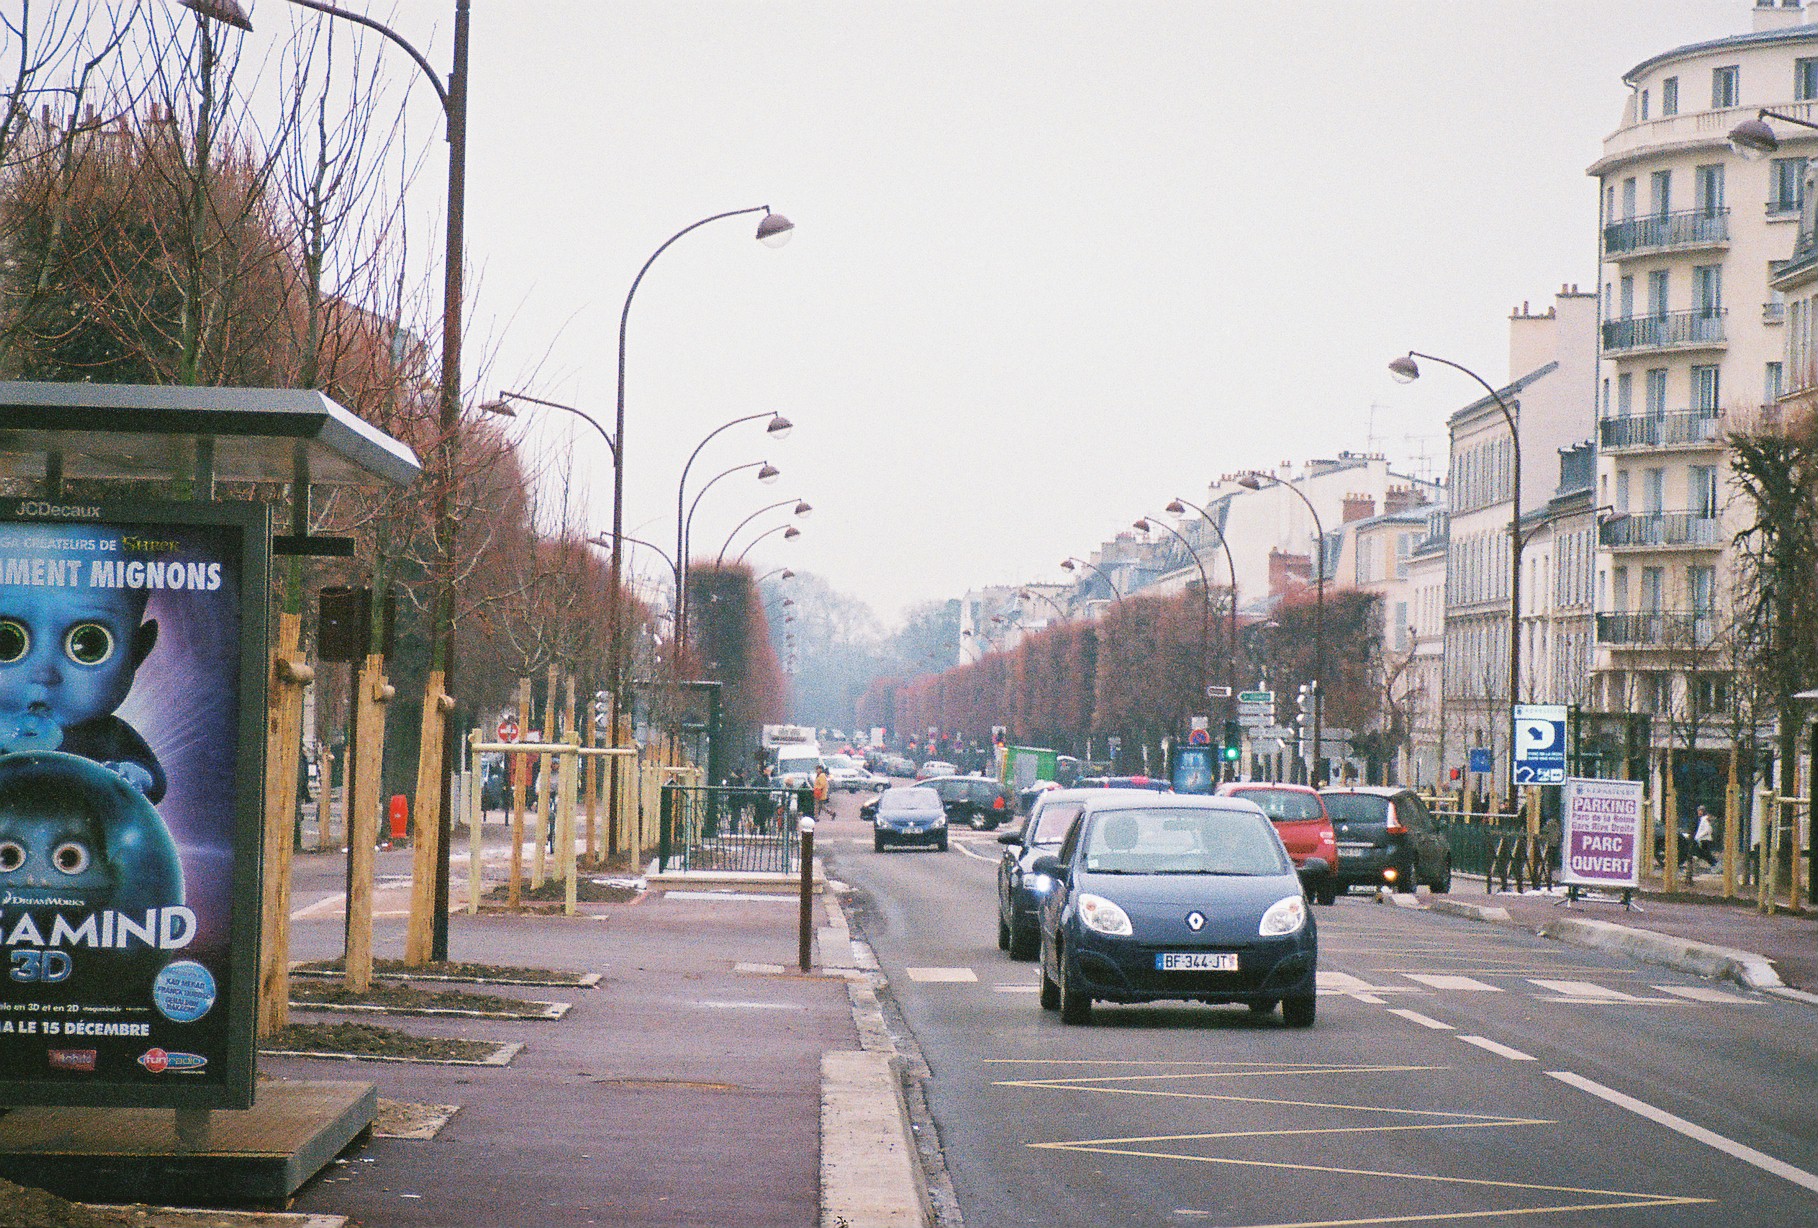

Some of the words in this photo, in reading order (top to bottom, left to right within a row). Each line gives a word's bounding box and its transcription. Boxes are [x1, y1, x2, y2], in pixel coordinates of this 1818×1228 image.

[16, 501, 100, 518] JCDecaux
[100, 539, 117, 551] DE
[0, 558, 82, 587] MENT
[90, 560, 221, 590] MIGNONS
[1573, 798, 1635, 814] PARKING
[1582, 835, 1623, 852] PARC
[1572, 855, 1631, 873] OUVERT
[0, 905, 198, 950] AMIND
[9, 949, 73, 983] 3D
[28, 1003, 40, 1011] 3D
[53, 1004, 65, 1012] en
[67, 1004, 79, 1012] 2D
[0, 1020, 14, 1033] A
[18, 1020, 37, 1034] LE
[42, 1021, 60, 1035] 15
[64, 1019, 150, 1037] DÉCEMBRE
[146, 1054, 167, 1065] fun
